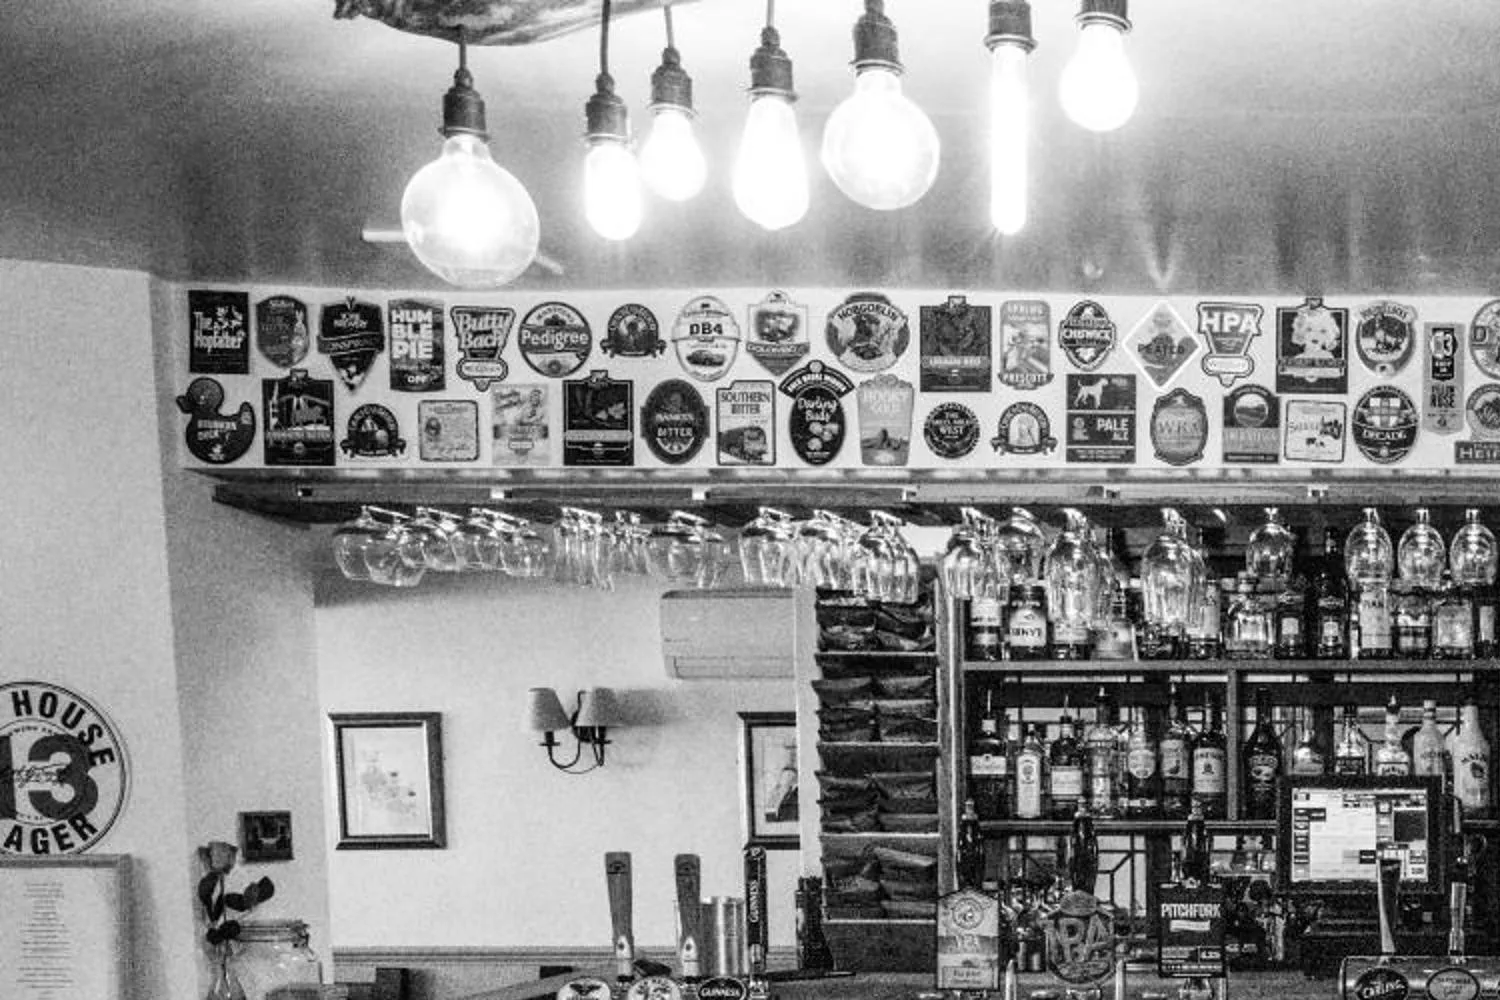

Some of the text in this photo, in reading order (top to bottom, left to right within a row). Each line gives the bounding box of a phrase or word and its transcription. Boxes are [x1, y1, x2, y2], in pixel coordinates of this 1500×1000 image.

[391, 310, 433, 322] HUM
[1201, 311, 1260, 333] HPA
[391, 324, 433, 339] BLE
[689, 323, 724, 336] DB4
[521, 330, 589, 351] Pedigree
[391, 341, 433, 359] PIE
[720, 391, 771, 403] SOUTHERN
[11, 690, 115, 766] HOUSE
[3, 812, 98, 855] AGER
[1160, 903, 1222, 919] PITCHFORK
